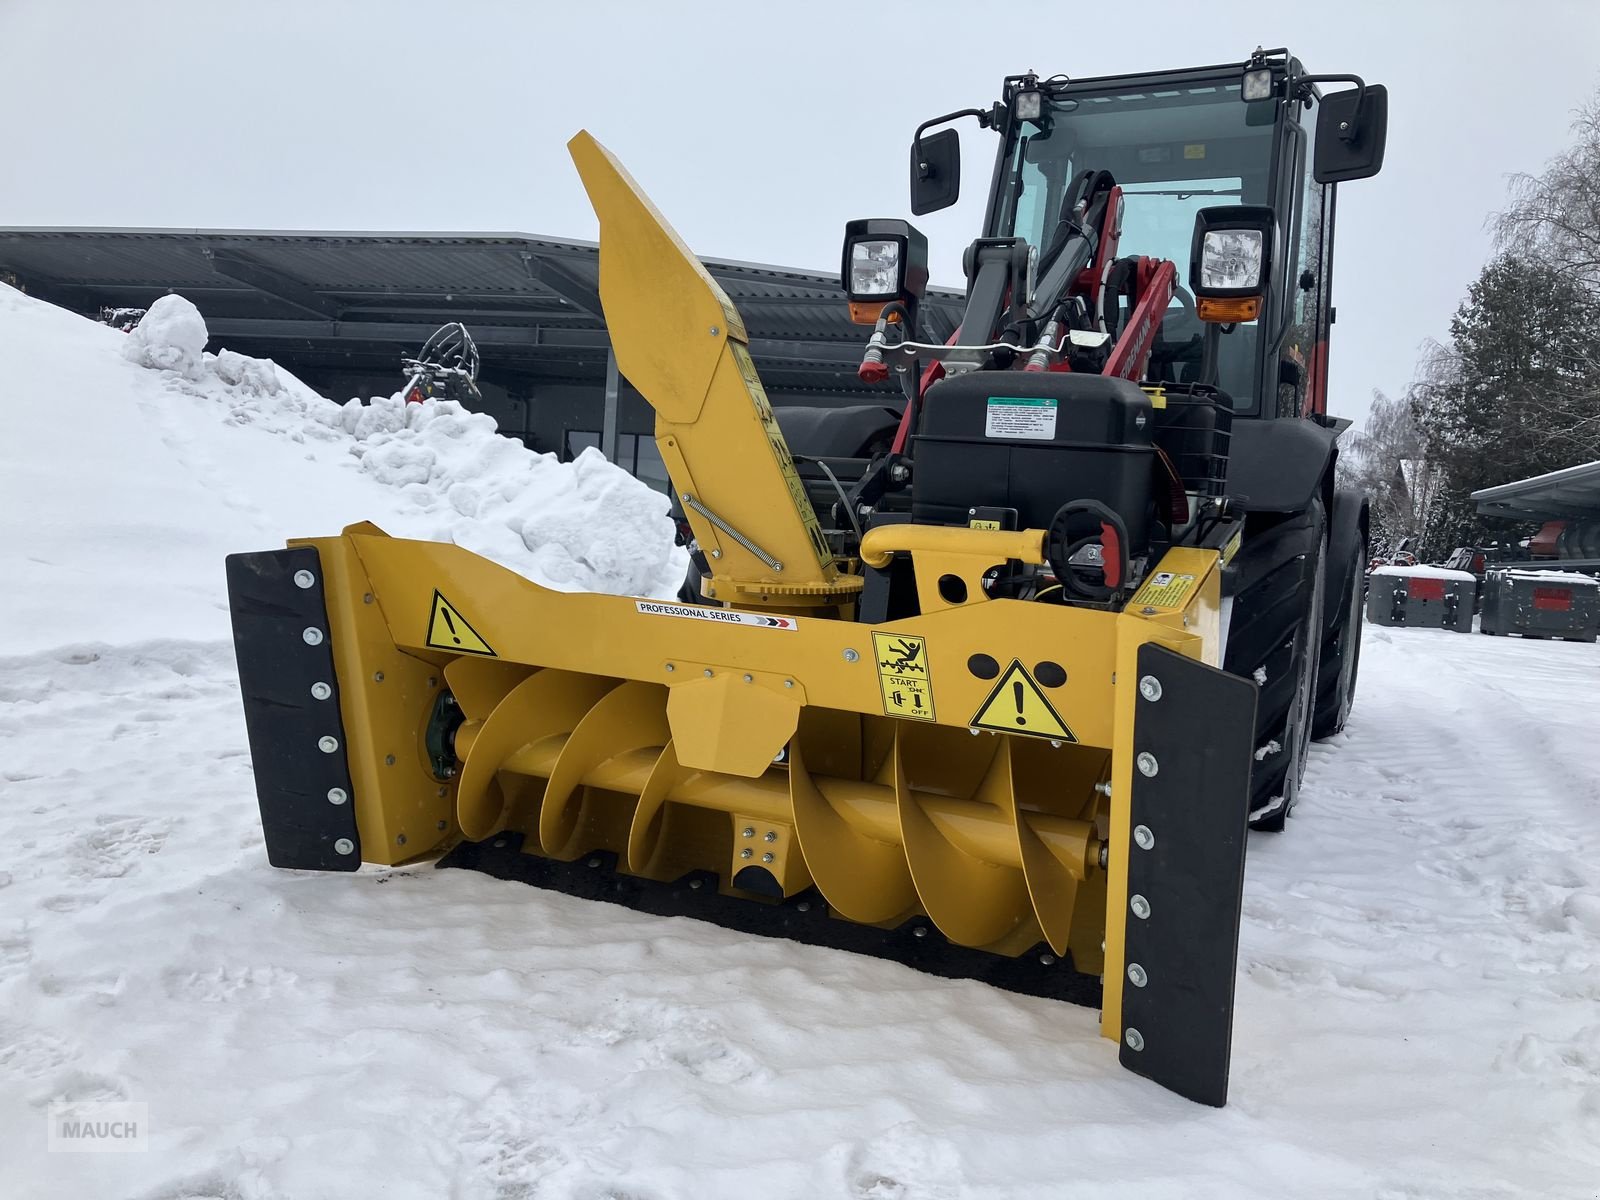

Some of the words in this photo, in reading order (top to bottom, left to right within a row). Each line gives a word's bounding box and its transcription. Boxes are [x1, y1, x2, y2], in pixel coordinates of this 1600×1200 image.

[1120, 312, 1150, 379] EIDEMANN
[640, 603, 709, 619] PROFESSIONAL
[710, 611, 741, 622] SERIES
[890, 678, 917, 687] START
